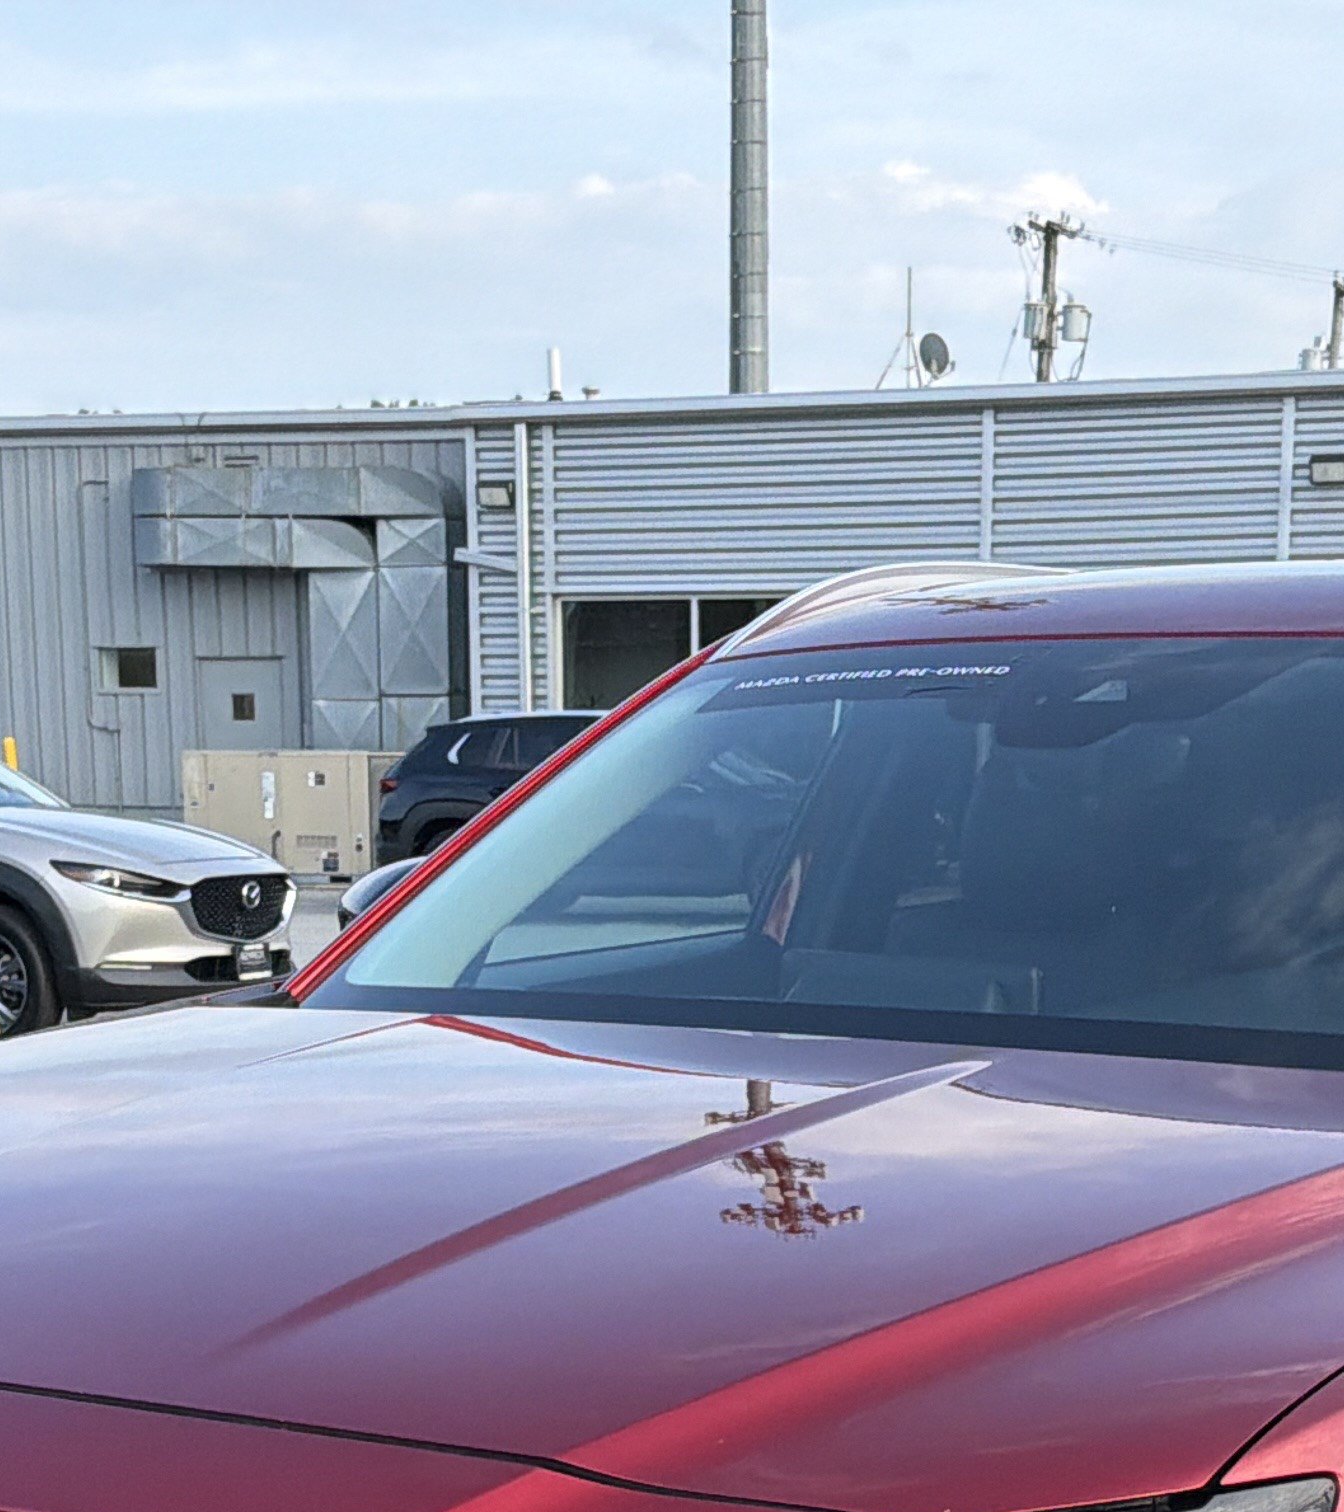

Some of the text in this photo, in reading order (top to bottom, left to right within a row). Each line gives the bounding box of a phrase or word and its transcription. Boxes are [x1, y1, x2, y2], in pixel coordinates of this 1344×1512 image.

[735, 666, 1010, 690] MAZDA CERTIFIED PRE-OWNED
